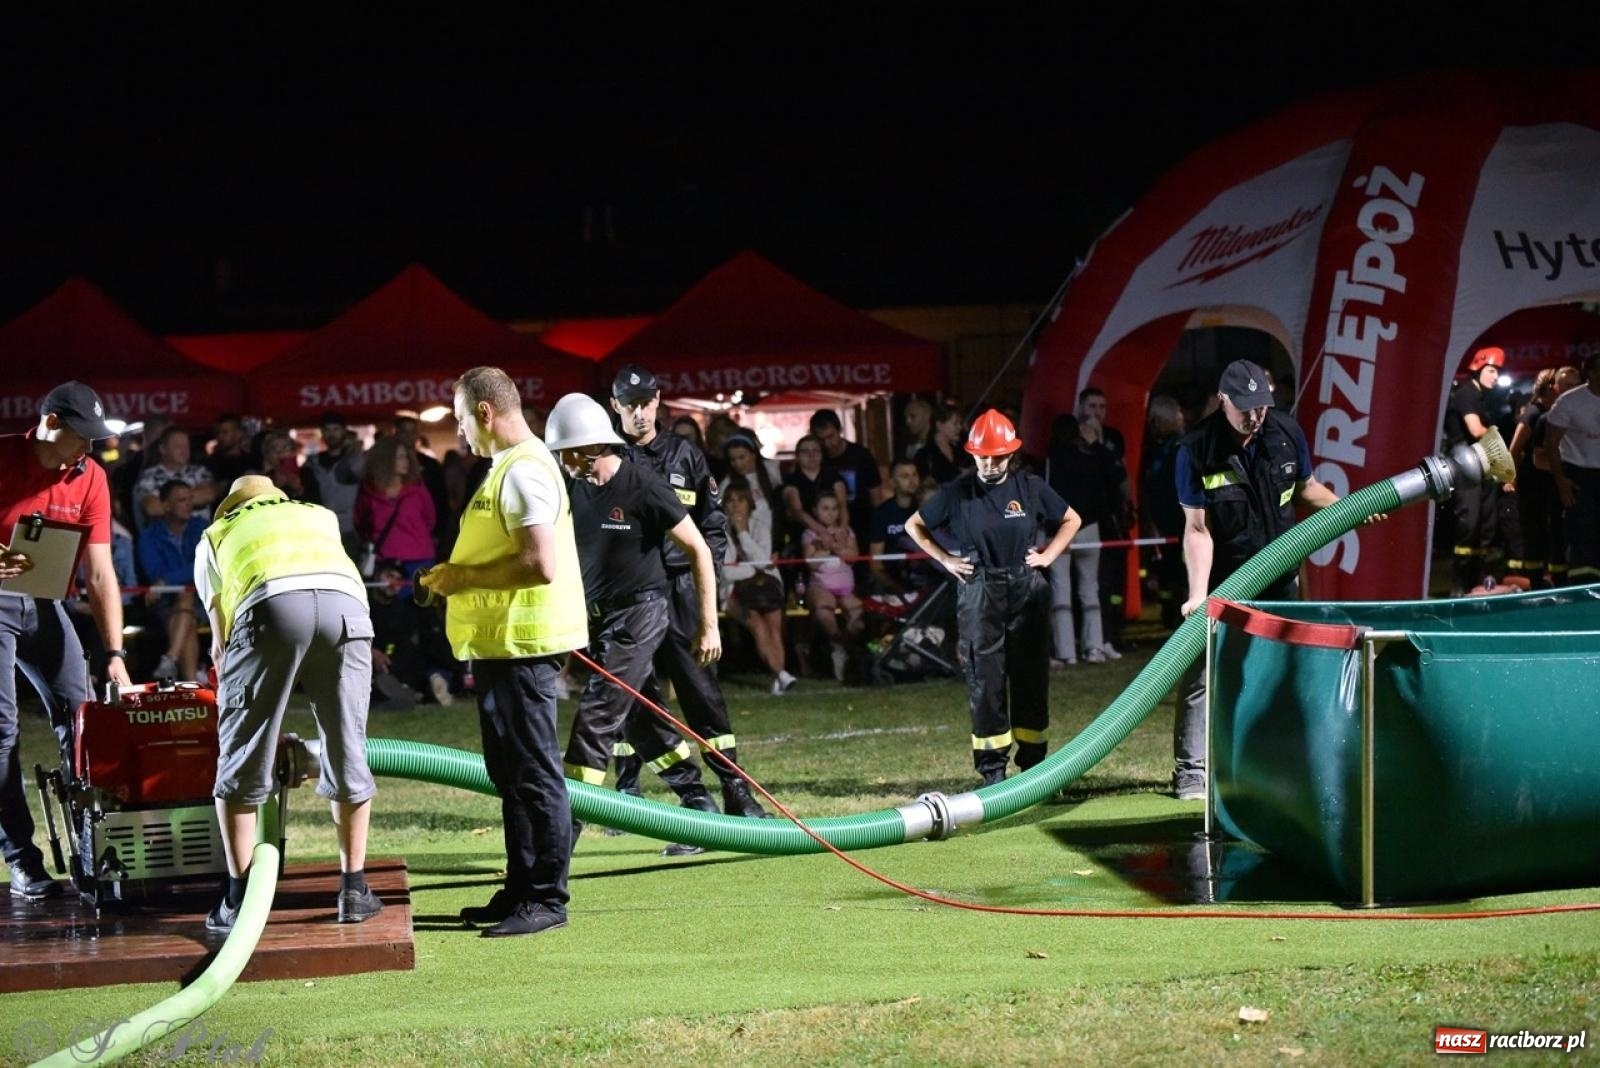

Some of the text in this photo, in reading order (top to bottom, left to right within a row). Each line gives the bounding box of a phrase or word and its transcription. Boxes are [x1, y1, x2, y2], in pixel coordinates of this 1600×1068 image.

[299, 377, 545, 407] SAMBORE
[656, 364, 891, 393] SAMBOROWICE
[125, 705, 208, 724] TOHATSU
